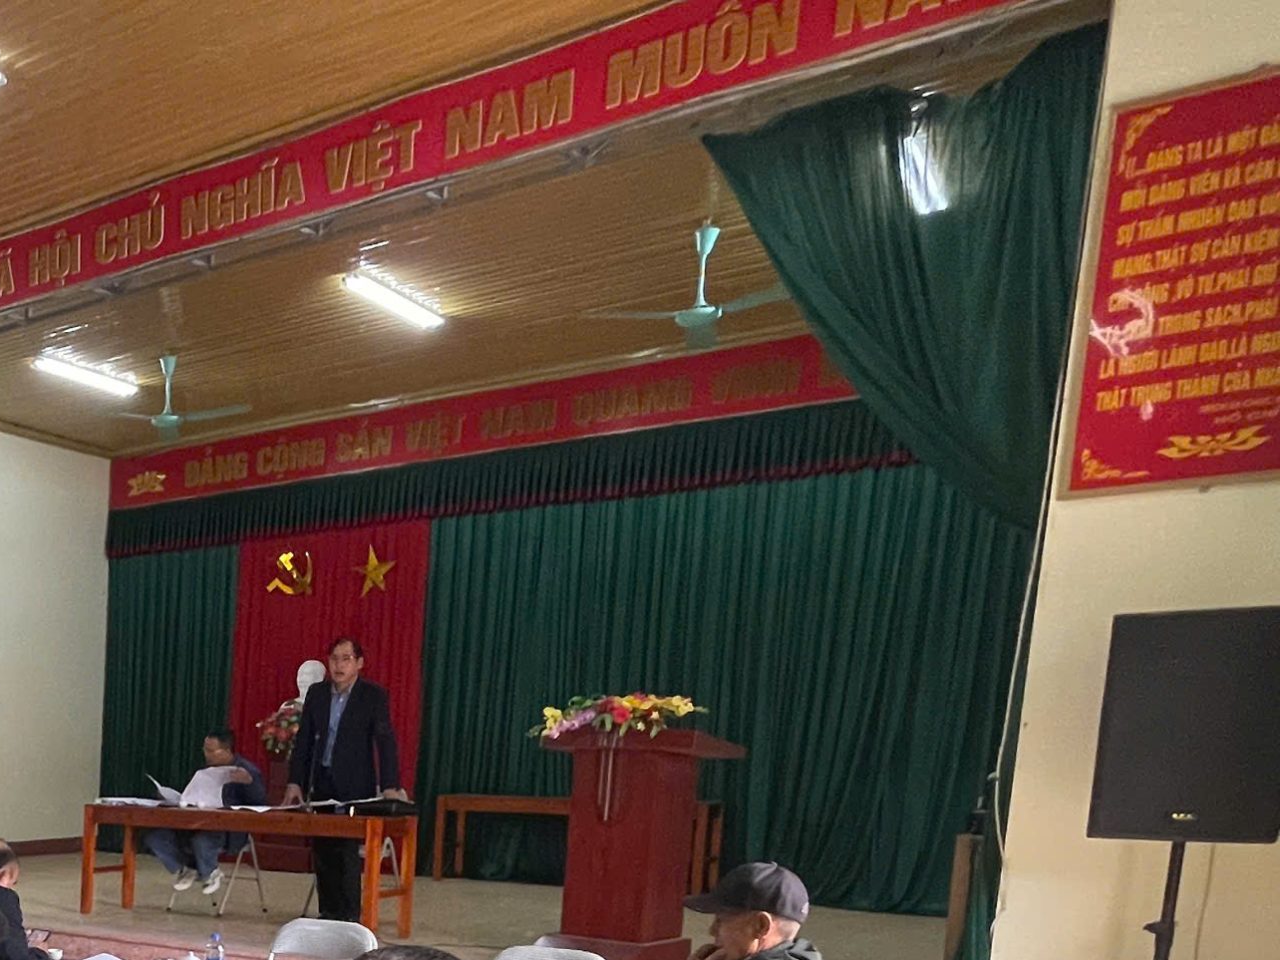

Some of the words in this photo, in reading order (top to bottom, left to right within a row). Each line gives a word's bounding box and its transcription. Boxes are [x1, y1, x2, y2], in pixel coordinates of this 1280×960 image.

[28, 233, 81, 288] HỘI
[95, 192, 165, 264] CHỦ
[180, 157, 305, 241] NGHĨA
[324, 120, 422, 194] VIỆT
[444, 68, 575, 160] NAM
[602, 0, 800, 110] MUÔN
[255, 437, 326, 479] CỘNG
